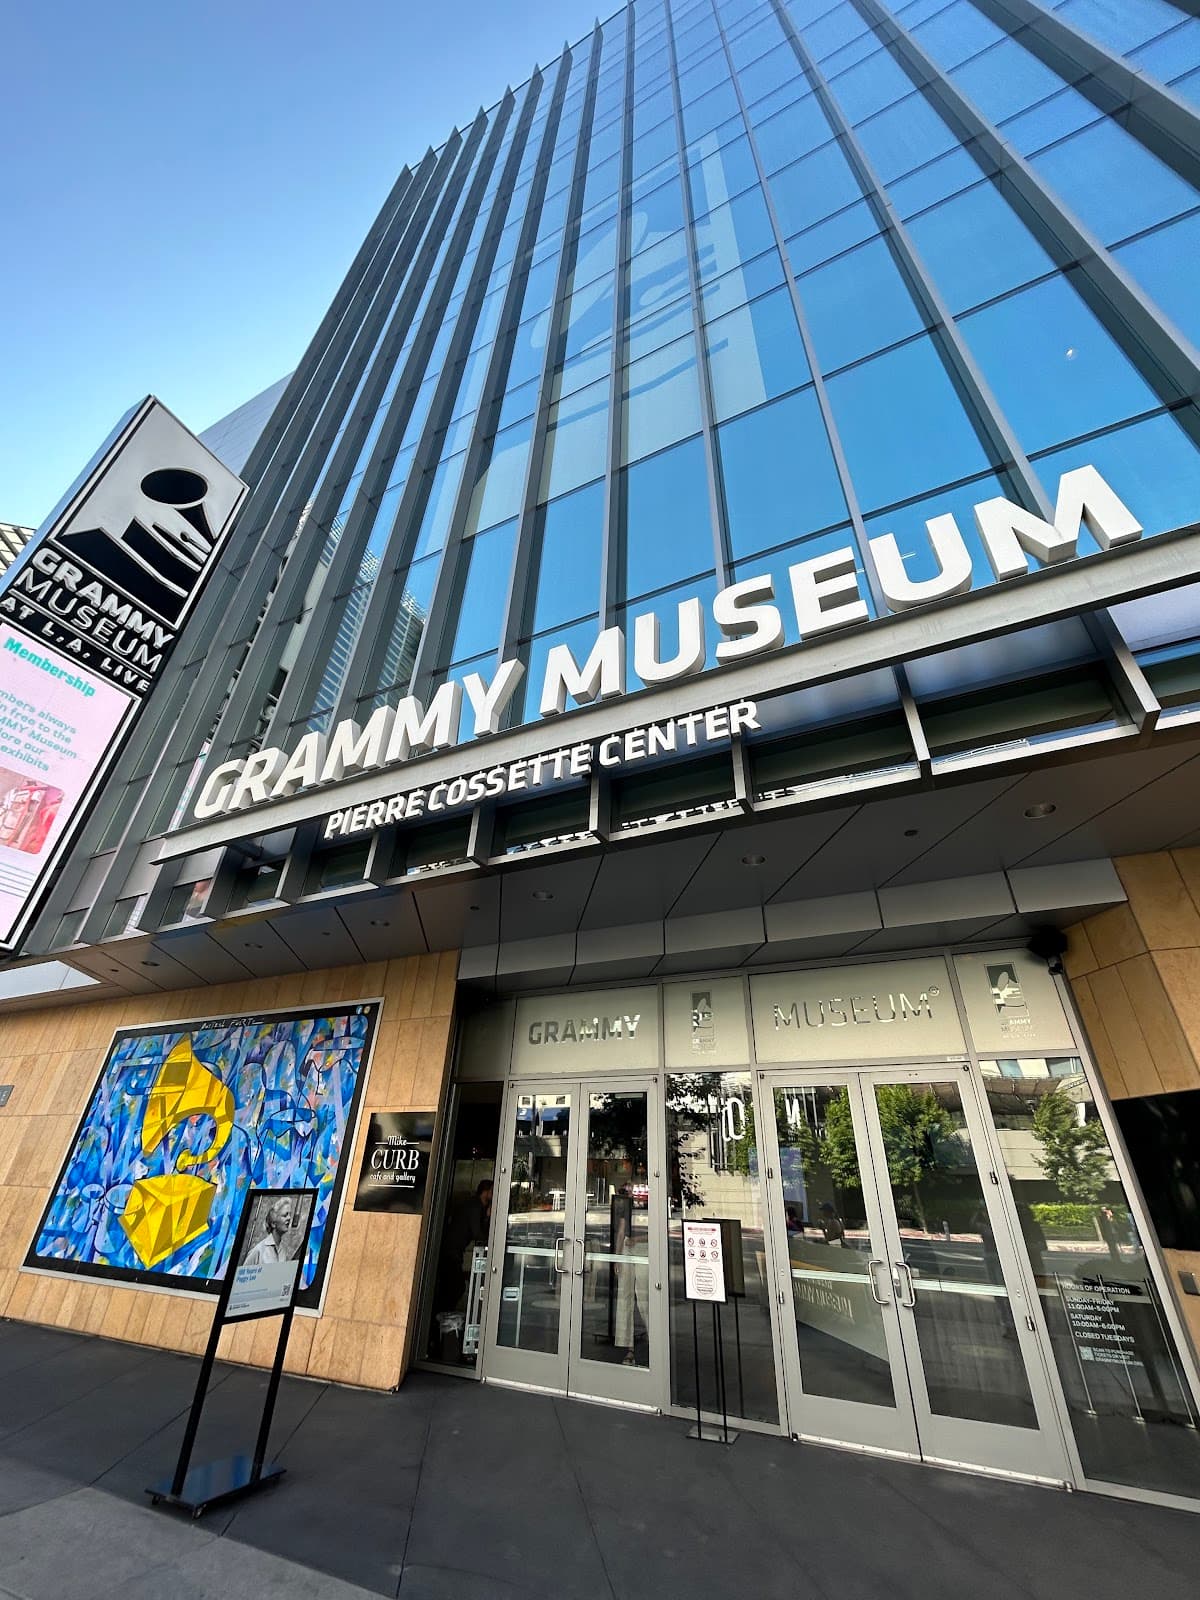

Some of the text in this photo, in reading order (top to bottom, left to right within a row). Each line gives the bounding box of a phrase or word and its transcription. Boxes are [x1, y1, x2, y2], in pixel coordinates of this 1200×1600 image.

[31, 548, 174, 649] GRAMMY
[14, 567, 162, 672] MUSEUM
[0, 597, 150, 692] AT L.A. LIVE
[194, 464, 1143, 820] GRAMMY MUSEUM
[4, 637, 96, 697] Membership
[0, 690, 76, 735] mbers always
[10, 707, 35, 726] free
[39, 722, 50, 733] to
[53, 730, 72, 744] the
[0, 745, 49, 772] exhibits
[24, 742, 45, 756] our
[28, 730, 77, 759] Museum
[323, 699, 762, 840] PIERRE COSSETTE CENTER
[529, 1013, 642, 1046] GRAMMY
[388, 1135, 407, 1146] Mike
[371, 1149, 419, 1170] CURB
[383, 1172, 395, 1181] and
[396, 1172, 416, 1184] gallery
[1094, 1285, 1131, 1294] OPERATION
[1071, 1313, 1102, 1321] SATURDAY
[1075, 1331, 1135, 1343] CLOSED TUESDAYS
